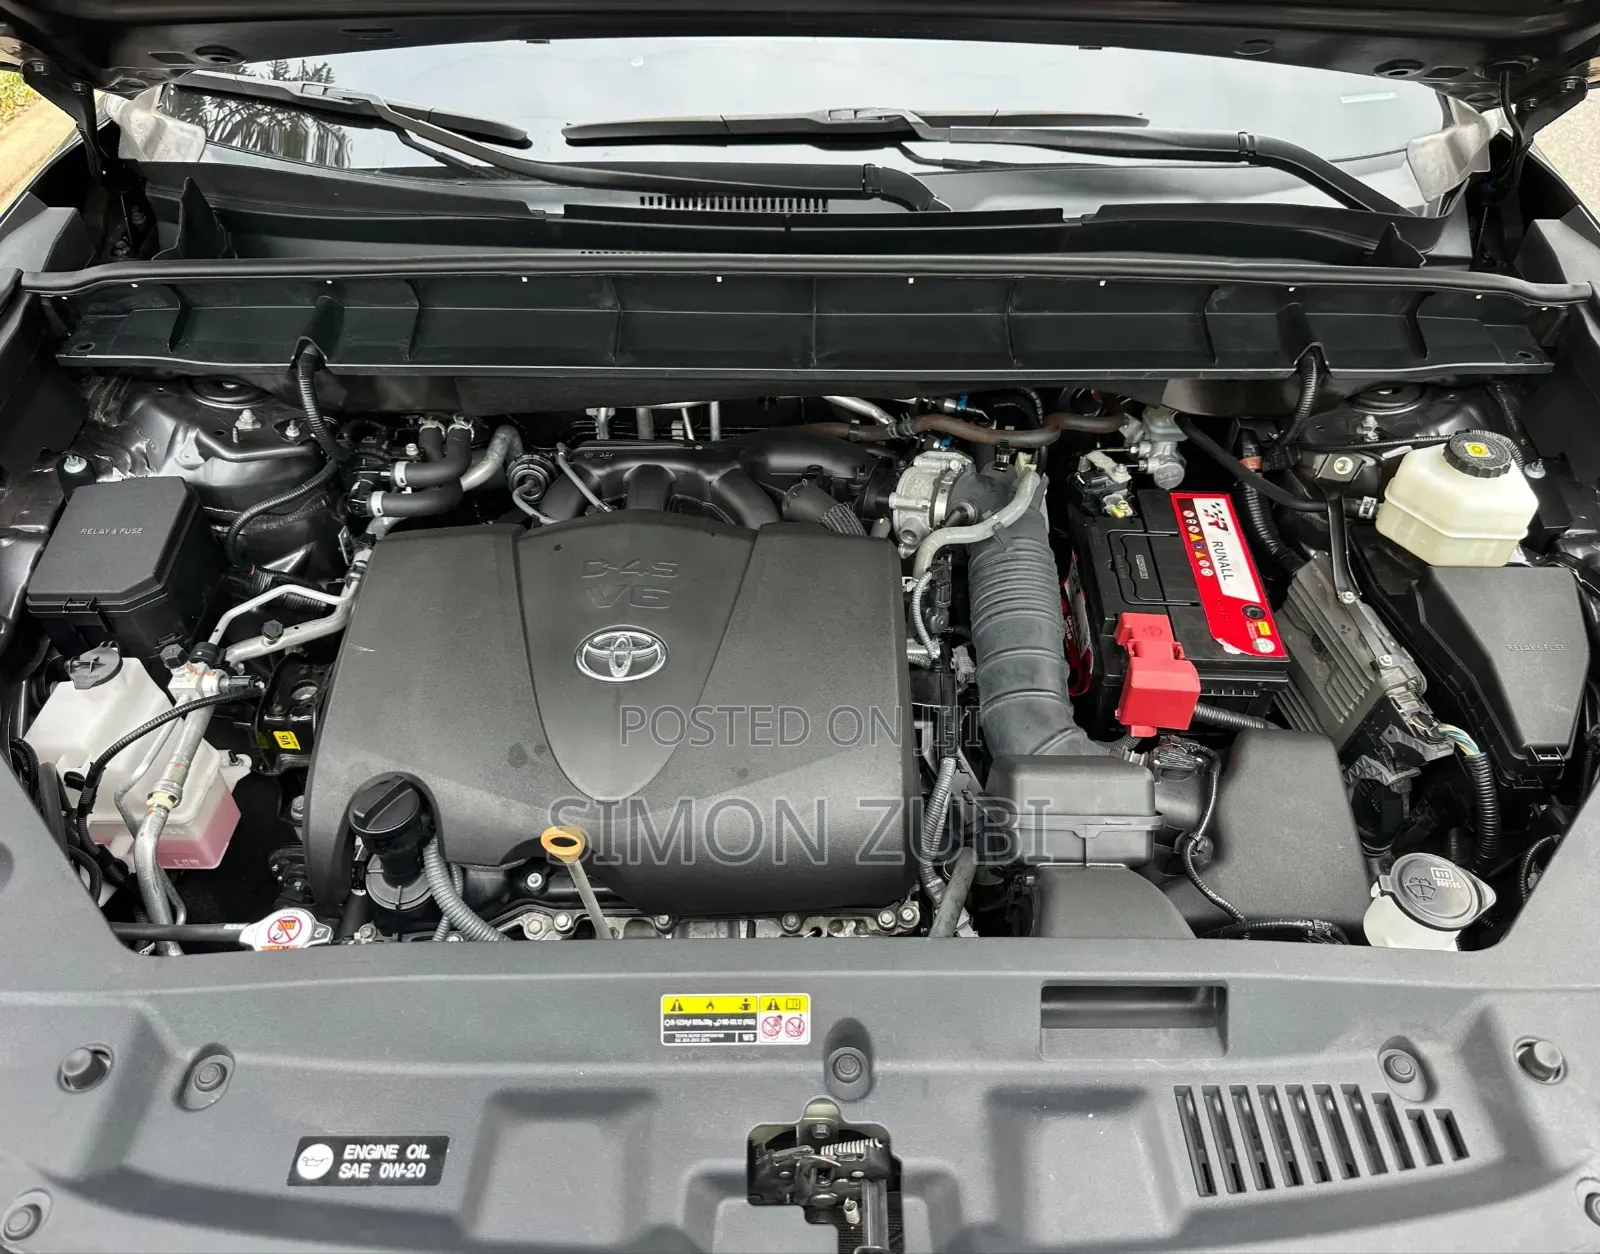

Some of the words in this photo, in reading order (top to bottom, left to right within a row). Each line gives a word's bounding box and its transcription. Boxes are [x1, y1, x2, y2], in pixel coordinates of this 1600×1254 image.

[1211, 540, 1235, 581] RUNALL
[1506, 644, 1535, 652] RELAY
[1543, 644, 1567, 652] FUSE
[343, 1143, 400, 1160] ENGINE
[405, 1143, 431, 1160] OIL
[338, 1162, 372, 1179] SAE
[379, 1162, 427, 1179] 0W-20
